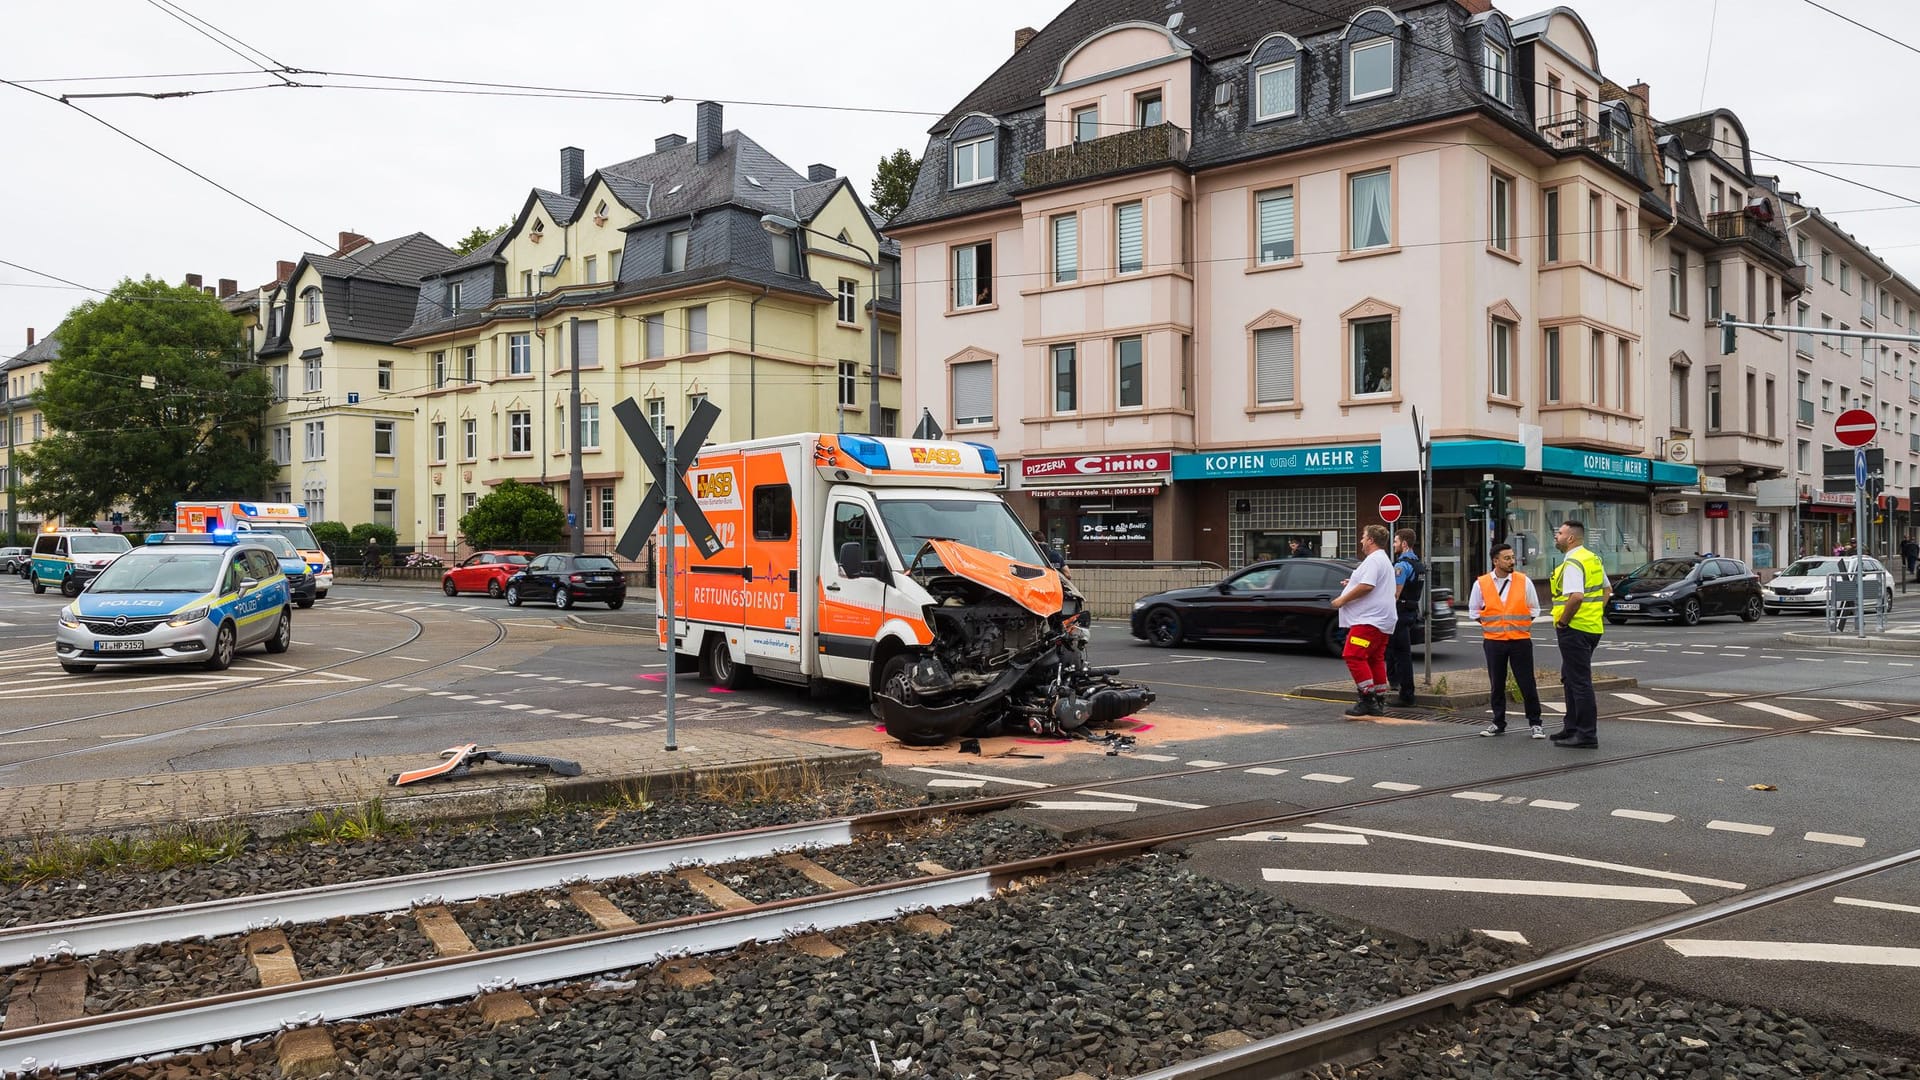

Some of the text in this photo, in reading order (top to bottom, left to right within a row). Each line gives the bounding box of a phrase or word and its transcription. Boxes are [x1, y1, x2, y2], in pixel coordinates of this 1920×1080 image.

[925, 448, 961, 465] ASB
[1205, 455, 1265, 470] KOPIEN
[1270, 455, 1297, 468] und
[1305, 451, 1354, 466] MEHR
[1584, 455, 1610, 470] KOPIEN
[1624, 460, 1642, 474] MEHR
[1026, 459, 1066, 475] PIZZERIA
[705, 472, 732, 497] ASB
[716, 522, 735, 548] 112
[239, 599, 257, 614] POLIZEI
[694, 586, 785, 610] RETTUNGSDIENST
